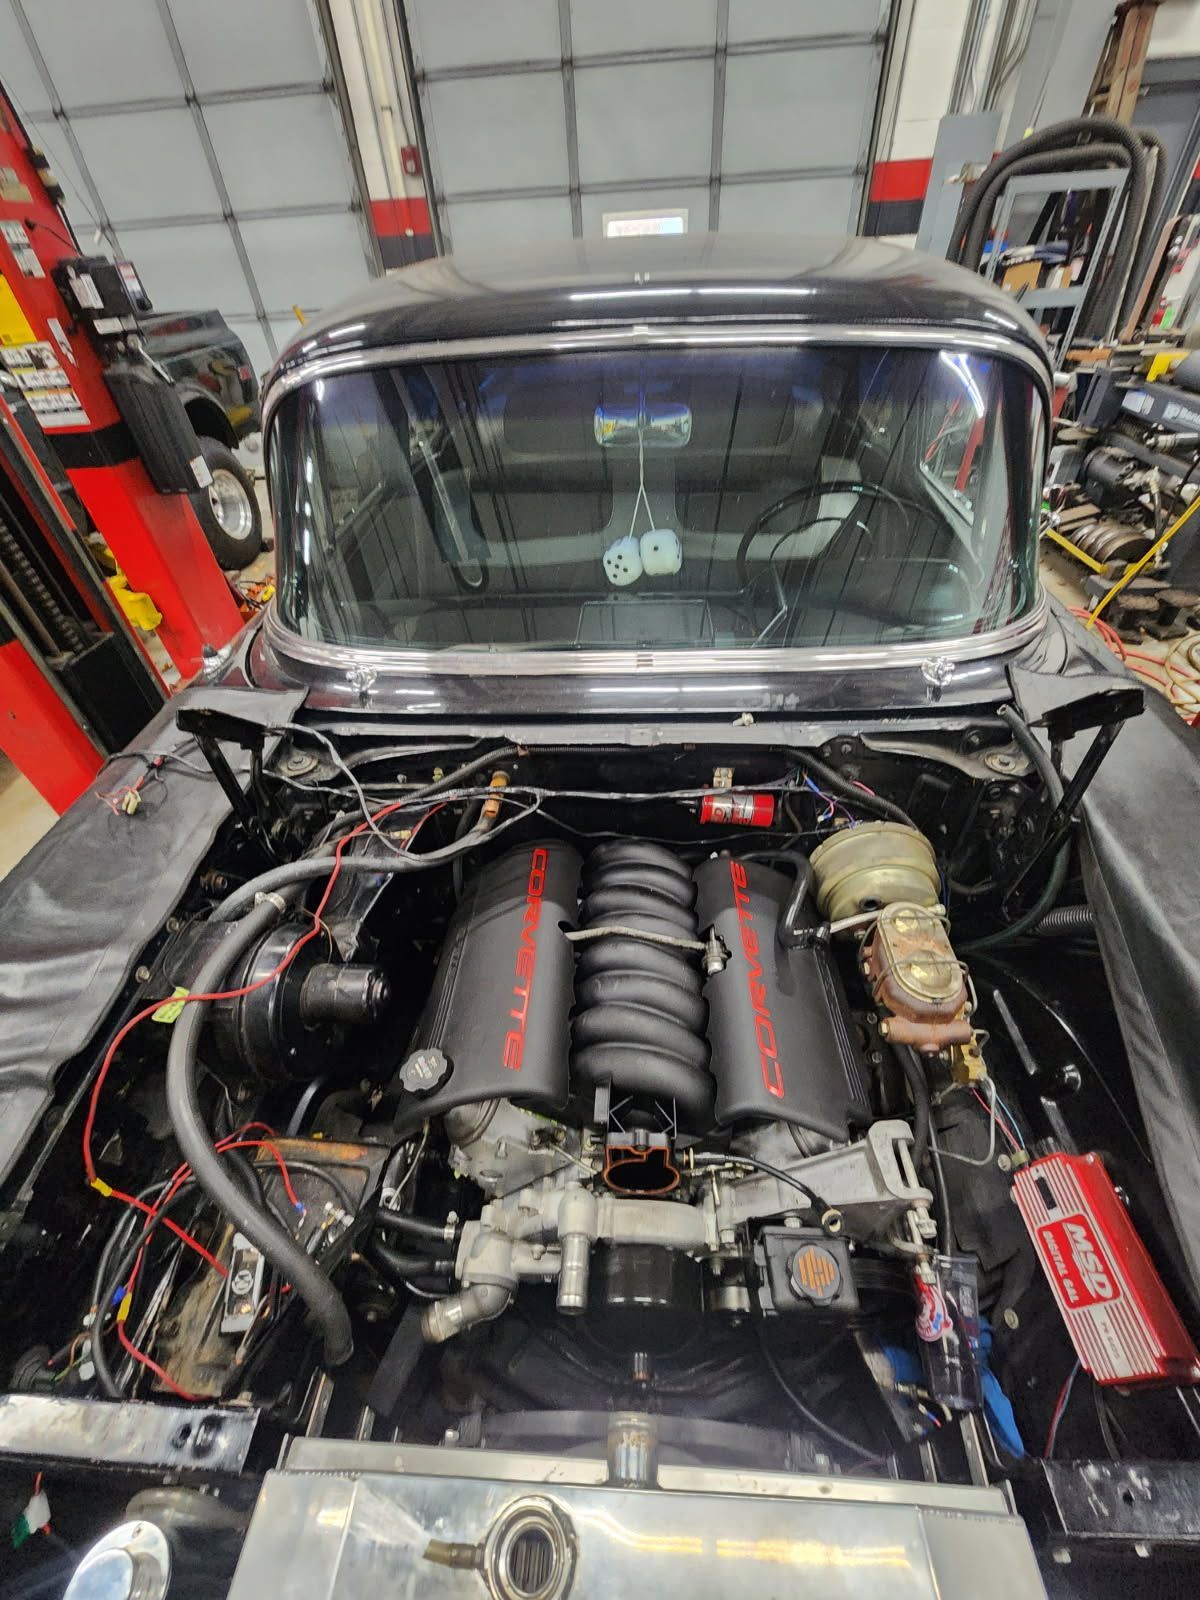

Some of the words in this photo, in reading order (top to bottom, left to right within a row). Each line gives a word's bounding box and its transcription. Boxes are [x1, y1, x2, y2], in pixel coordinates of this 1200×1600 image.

[503, 847, 548, 1073] CORVETTE
[730, 859, 786, 1099] CORVETTE
[1042, 1230, 1069, 1277] DIGITAL
[1064, 1221, 1114, 1300] MSD
